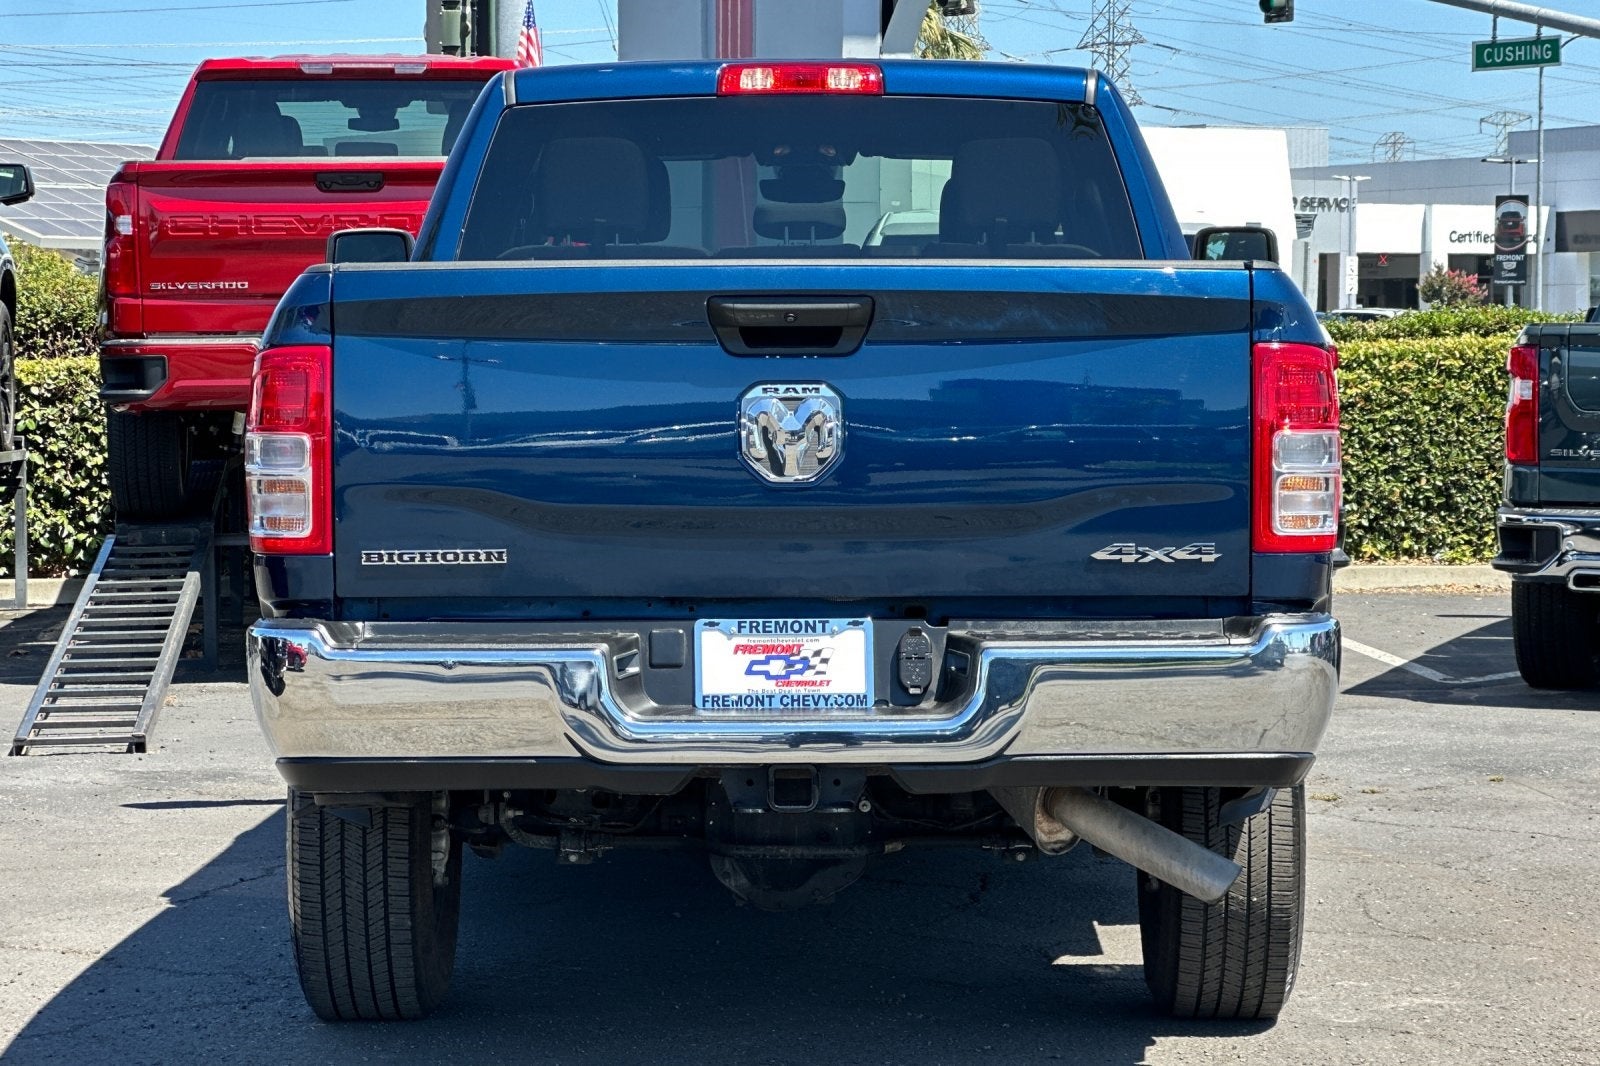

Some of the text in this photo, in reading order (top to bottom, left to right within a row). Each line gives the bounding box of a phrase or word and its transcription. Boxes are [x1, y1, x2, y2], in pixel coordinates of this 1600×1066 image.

[1484, 44, 1552, 63] CUSHING
[168, 214, 424, 236] CHEVRO
[150, 281, 249, 290] SILVERADO
[761, 387, 820, 395] RAM
[361, 549, 508, 565] BIGHORN
[737, 620, 830, 634] FREMONT
[733, 644, 804, 655] FREMONT
[775, 679, 832, 687] CHEVROLET
[702, 694, 868, 707] FREMONT CHEVY.COM
